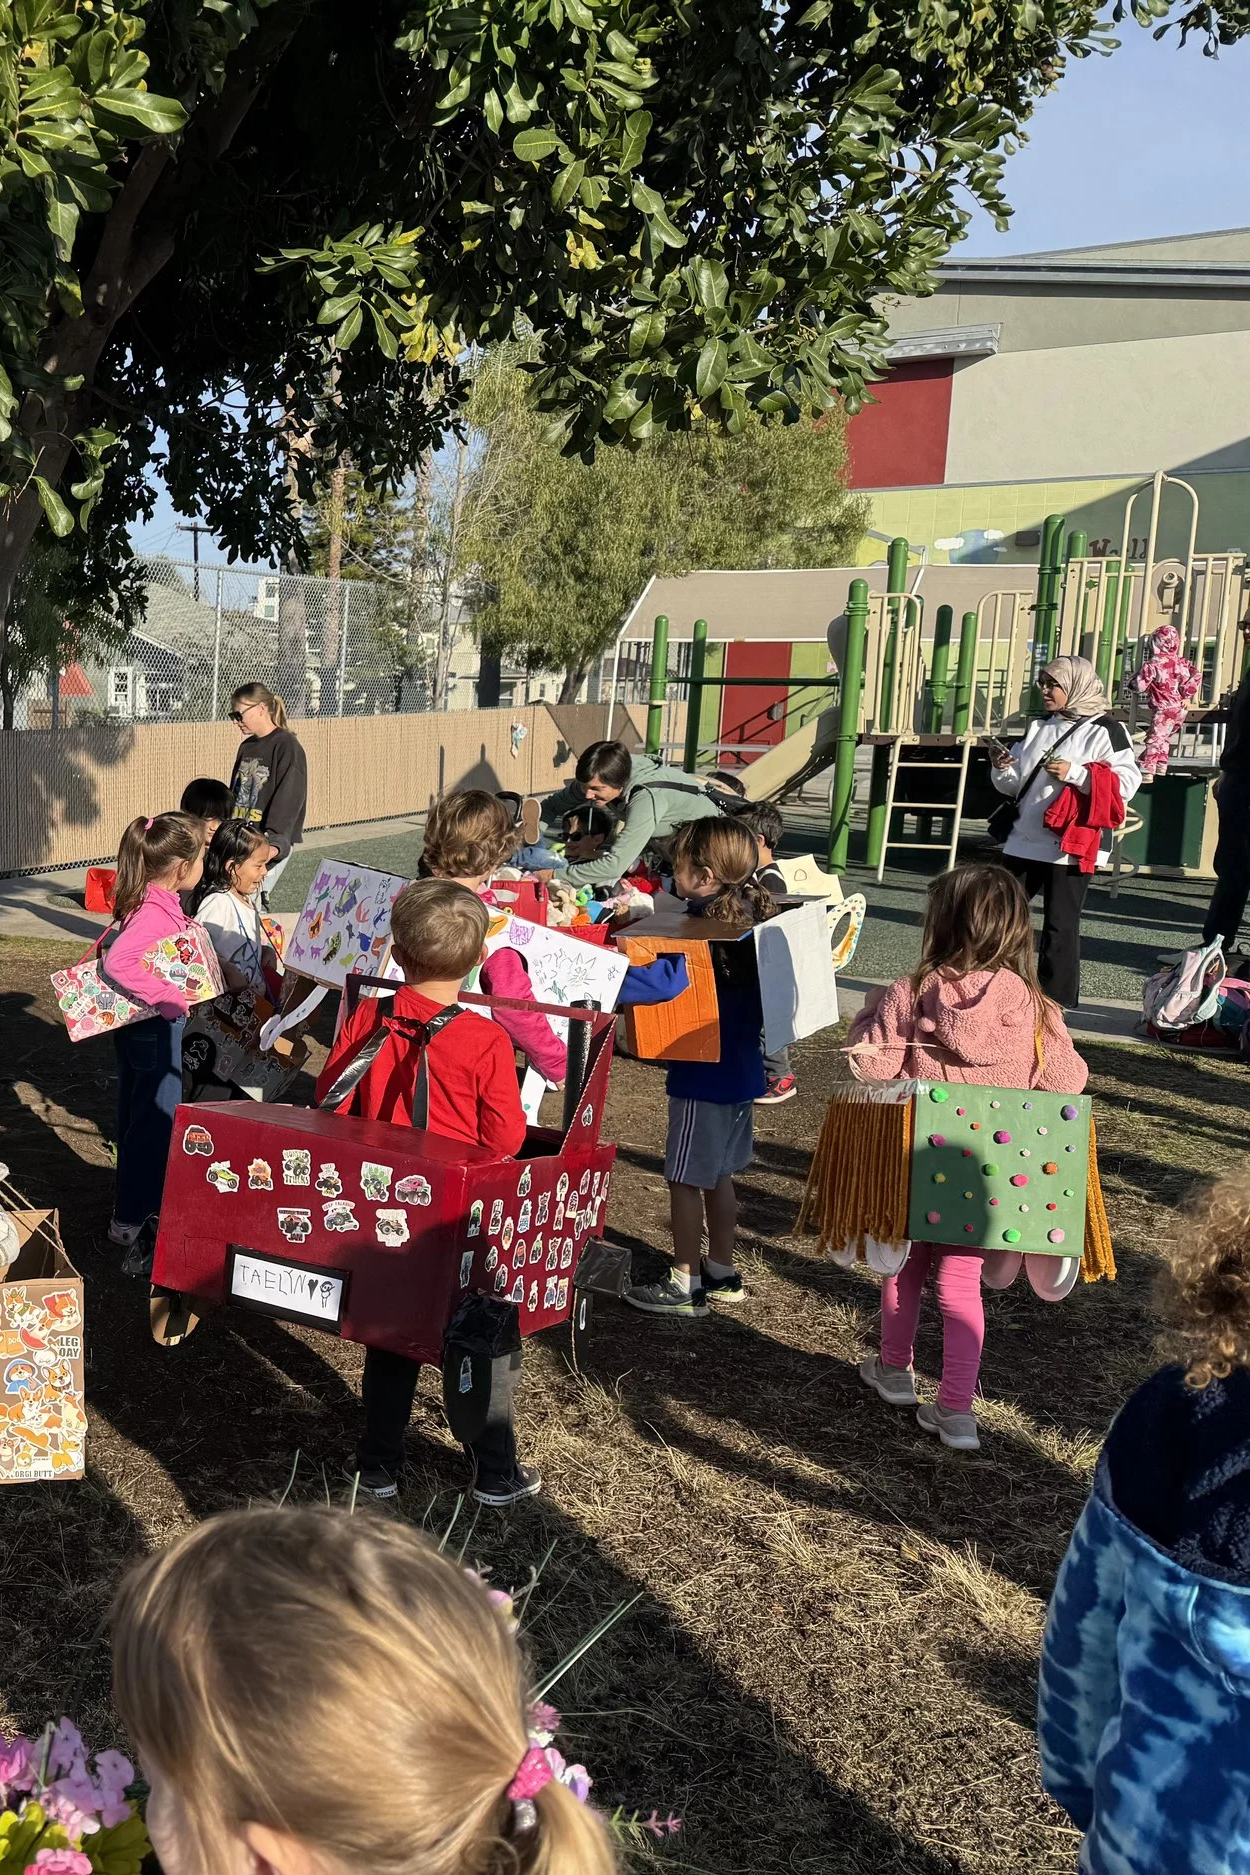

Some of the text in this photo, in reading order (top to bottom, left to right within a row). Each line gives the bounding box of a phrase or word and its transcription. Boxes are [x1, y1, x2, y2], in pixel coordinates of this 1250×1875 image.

[239, 1264, 307, 1295] TAELYN
[60, 1337, 79, 1347] LEG
[59, 1348, 79, 1357] DAY
[11, 1470, 53, 1478] ORGI BUTT
